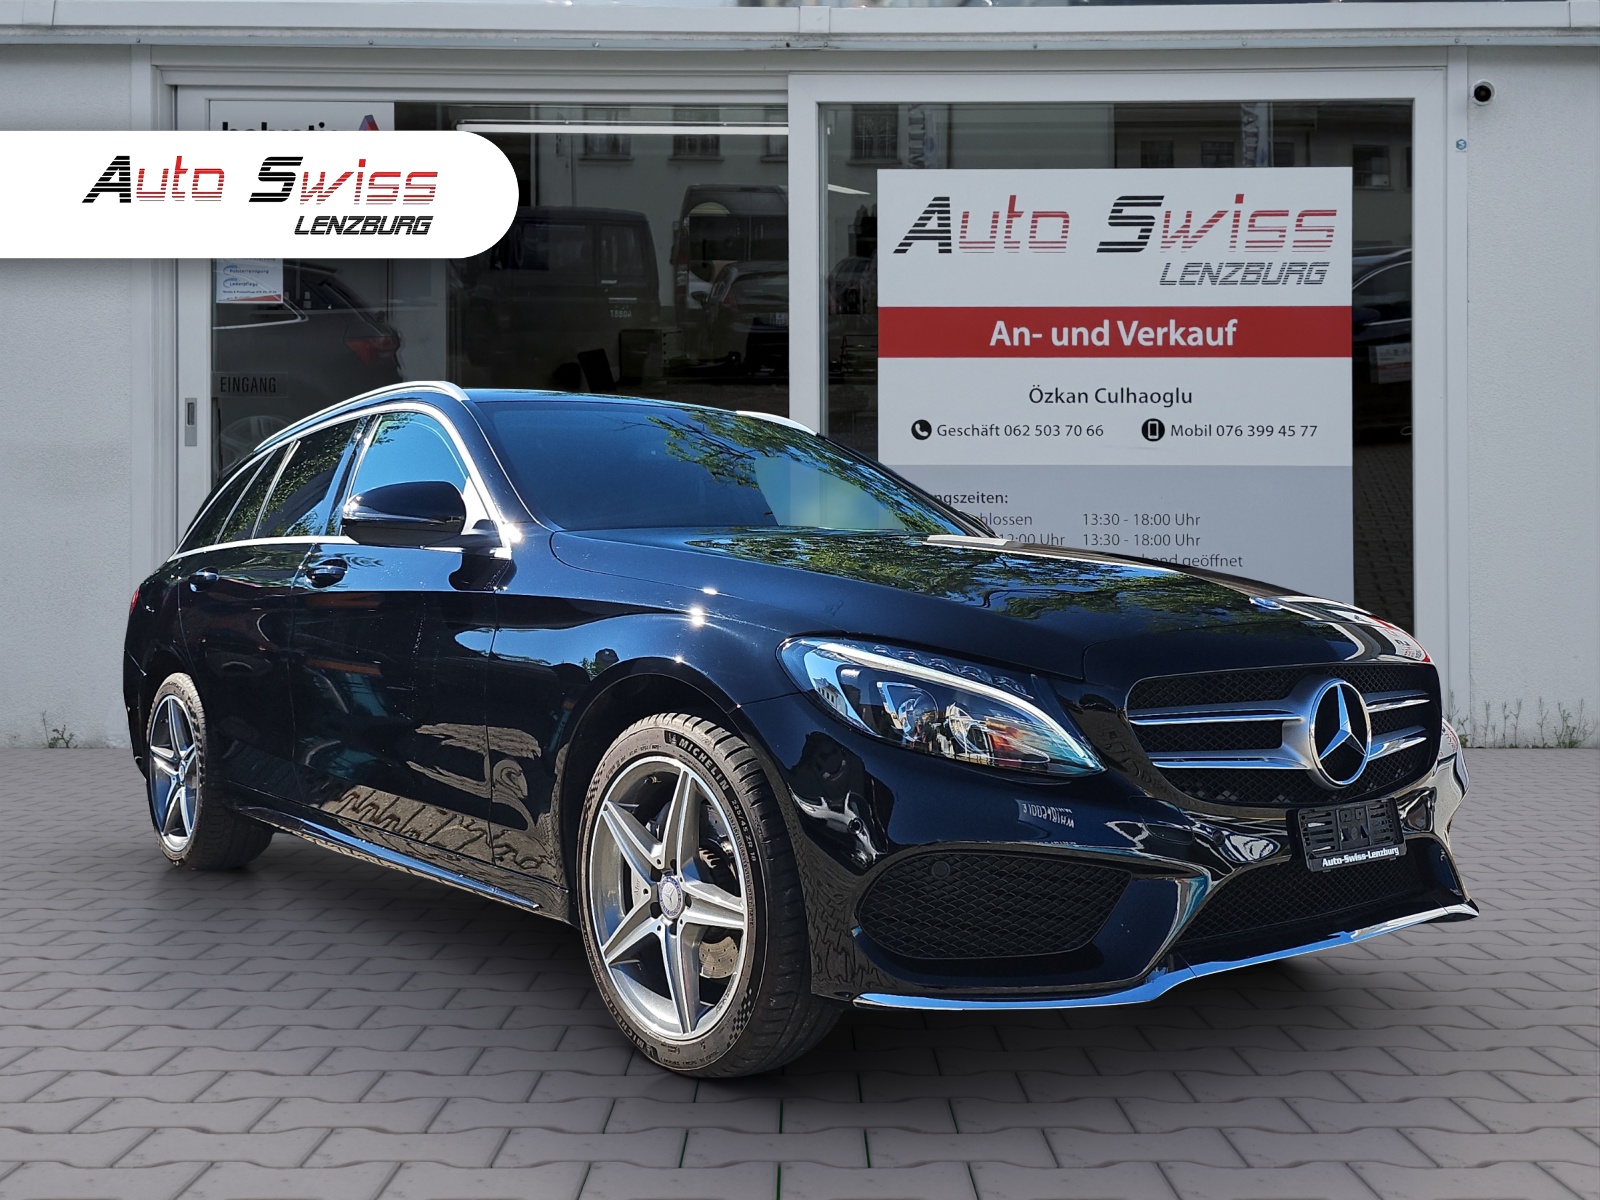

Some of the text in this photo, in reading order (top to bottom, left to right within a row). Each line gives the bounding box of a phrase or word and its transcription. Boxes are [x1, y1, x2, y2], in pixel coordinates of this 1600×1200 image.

[893, 193, 1337, 254] Auto Swiss
[1159, 261, 1331, 286] LENZBURG
[989, 318, 1238, 347] An- und Verkauf
[220, 376, 277, 393] EINGANG
[1028, 385, 1193, 409] Özkan Culhaoglu
[936, 422, 1105, 439] Geschäft 062 503 70 66
[1170, 423, 1318, 439] Mobil 076 399 45 77
[934, 491, 1009, 506] ngszeiten:
[1082, 513, 1120, 526] 13:30
[1133, 513, 1171, 526] 18:00
[1175, 512, 1201, 526] Uhr
[1040, 532, 1065, 546] Uhr
[1082, 533, 1120, 546] 13:30
[1133, 533, 1171, 546] 18:00
[1175, 532, 1201, 546] Uhr
[1182, 553, 1243, 567] geöffnet
[679, 737, 730, 792] MICHELIN
[731, 799, 750, 833] 225/45
[1322, 847, 1400, 868] Auto-Swiss-Lenzburg
[604, 992, 645, 1050] MICHELIN
